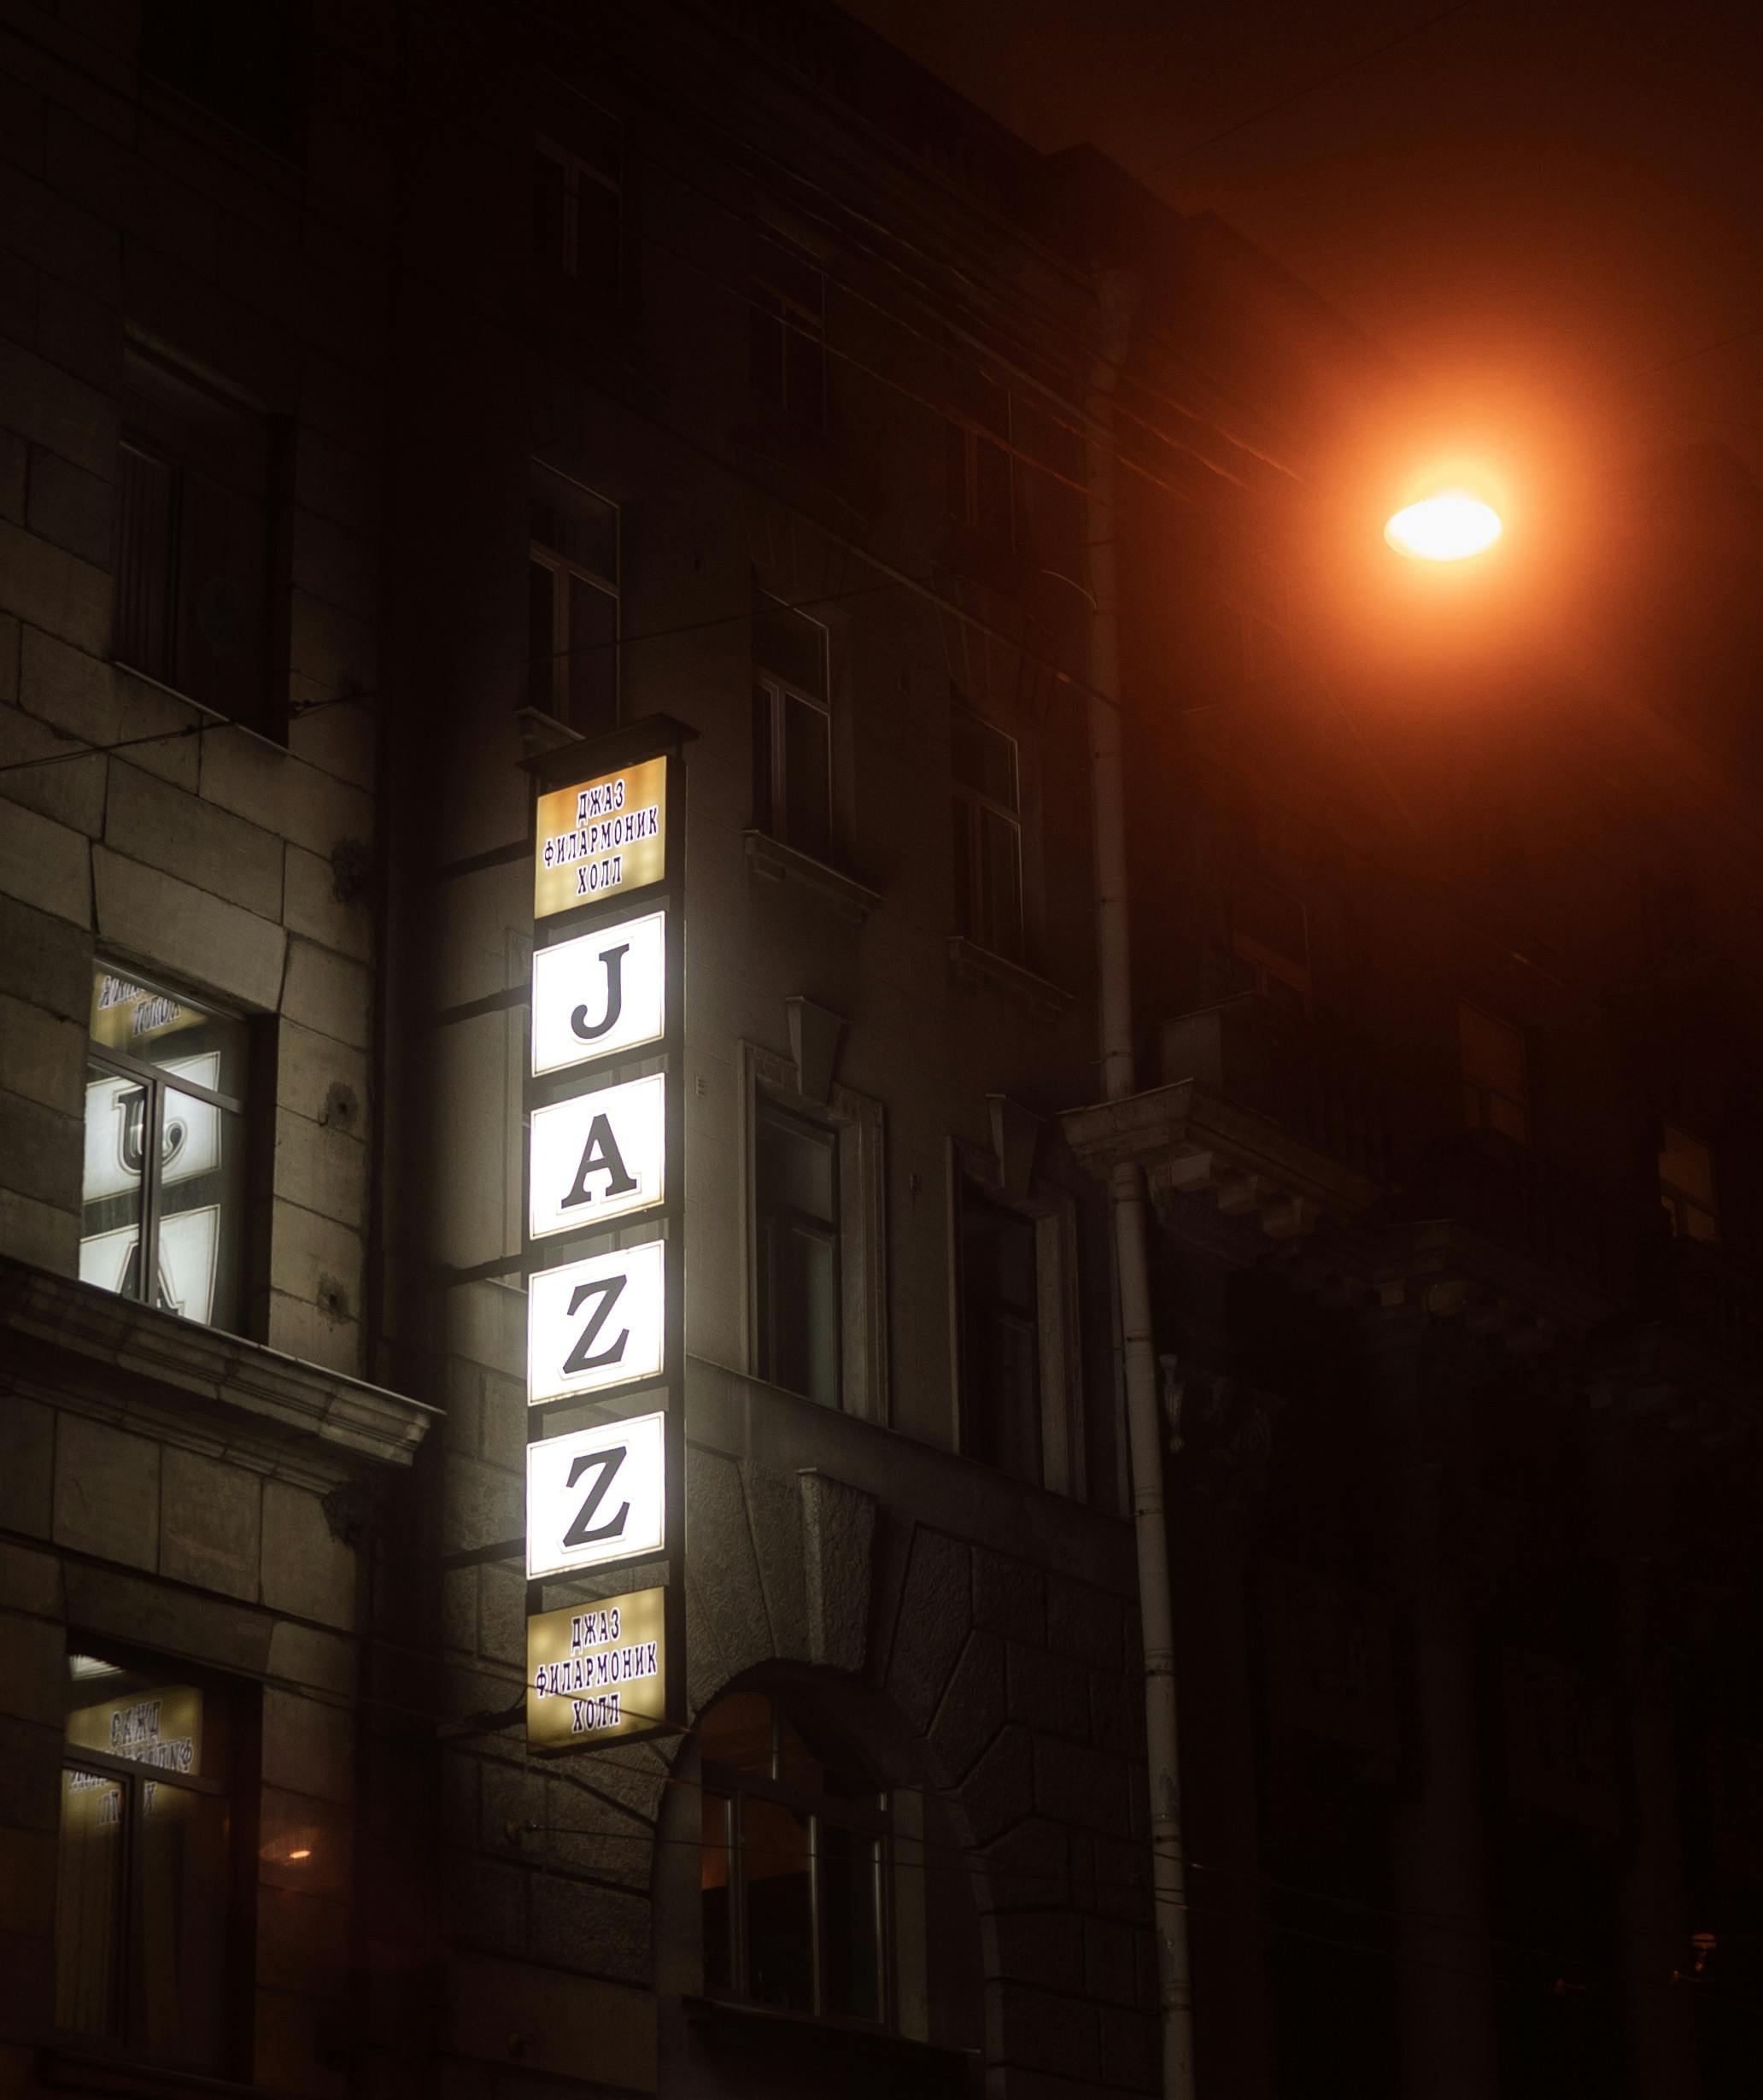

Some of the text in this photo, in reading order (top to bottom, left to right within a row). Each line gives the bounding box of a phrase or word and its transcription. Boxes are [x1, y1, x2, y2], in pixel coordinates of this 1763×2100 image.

[577, 781, 624, 823] ДЖАЗ
[543, 807, 659, 867] ФИЛАРМОНИК
[577, 855, 623, 895] ХОЛЛ
[560, 942, 638, 1548] JAZZ
[571, 1609, 620, 1651] ДЖАЗ
[536, 1642, 657, 1696] ФИЛАРМОНИК
[572, 1693, 619, 1733] ХОЛЛ
